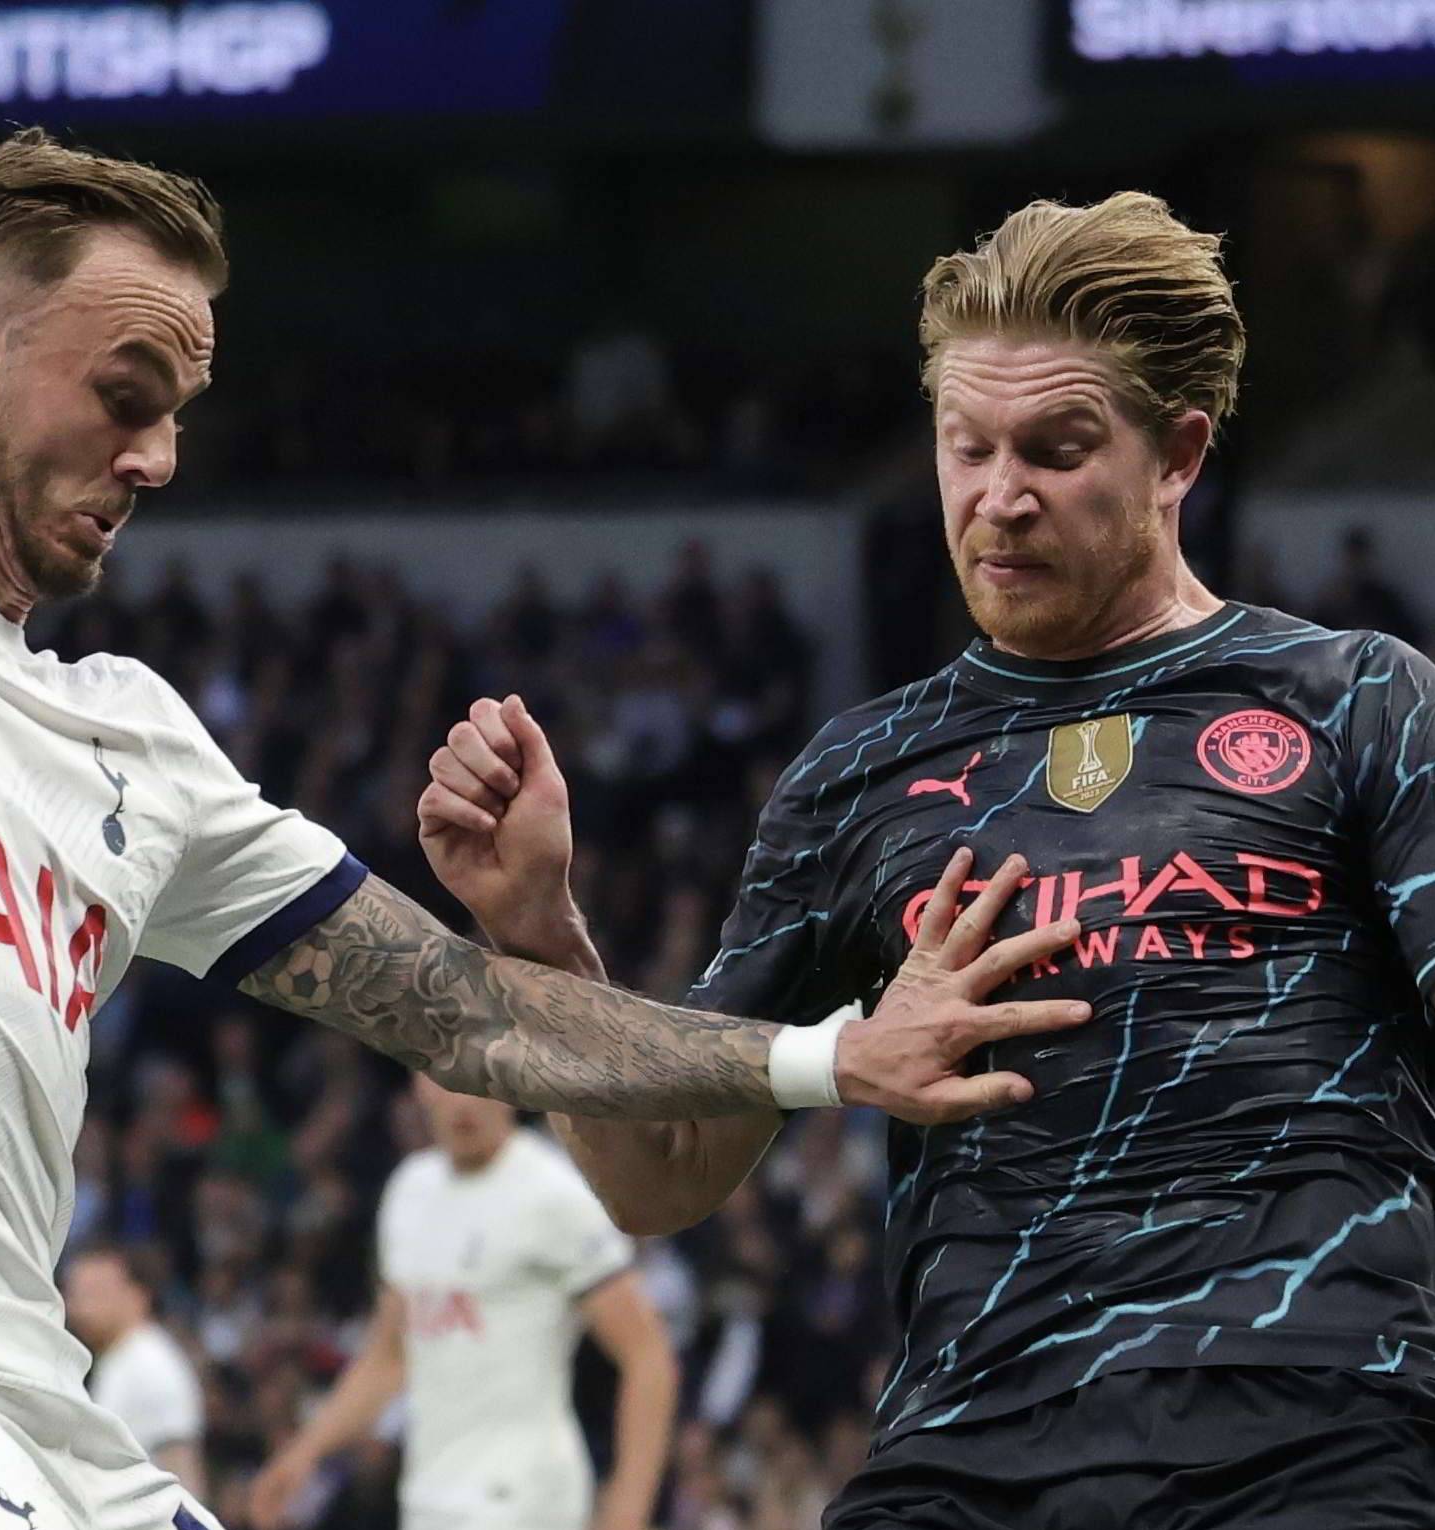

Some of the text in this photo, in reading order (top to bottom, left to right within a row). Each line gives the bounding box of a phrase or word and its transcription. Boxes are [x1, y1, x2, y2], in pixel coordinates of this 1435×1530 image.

[1210, 715, 1297, 741] MANCHESTER
[1071, 769, 1109, 790] FIFA
[1237, 774, 1270, 787] CITY
